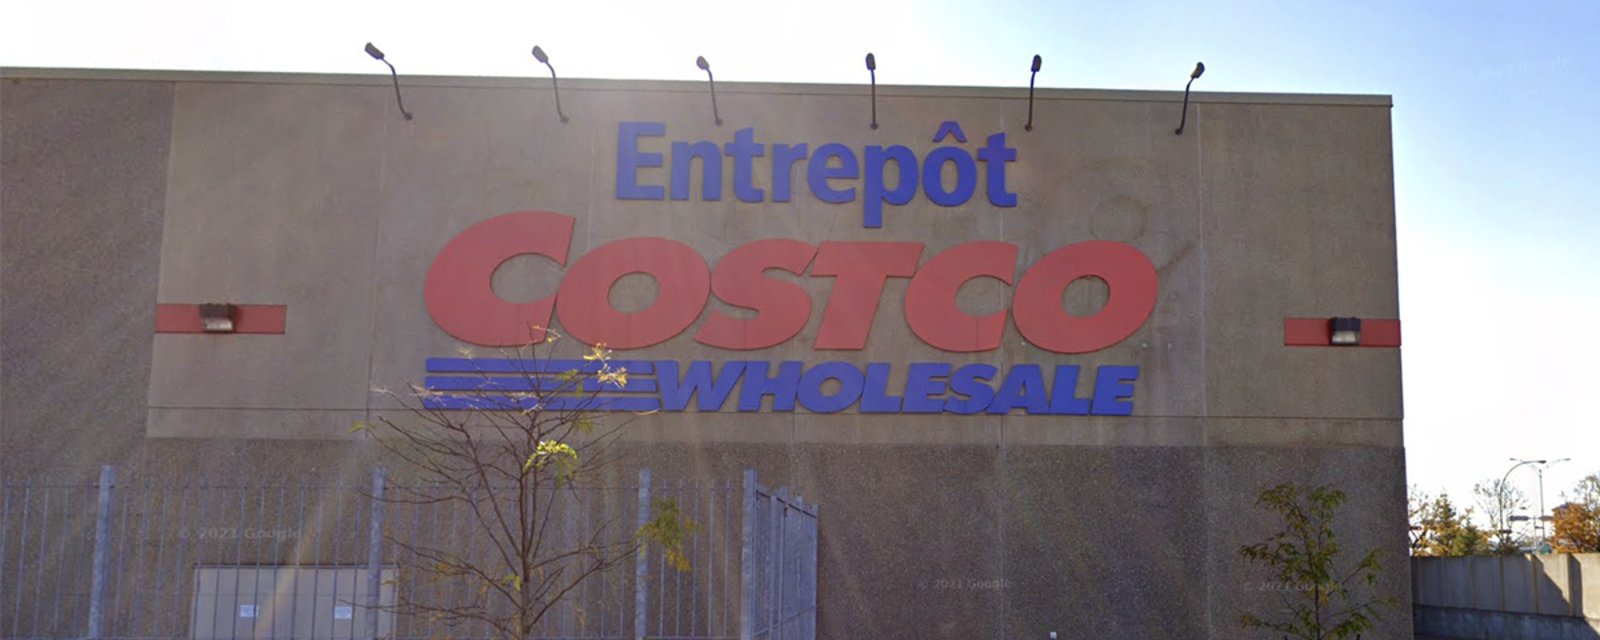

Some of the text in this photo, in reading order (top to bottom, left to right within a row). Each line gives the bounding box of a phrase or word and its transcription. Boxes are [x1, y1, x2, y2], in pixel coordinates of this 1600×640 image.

[615, 121, 1017, 227] Entrepôt
[424, 211, 1159, 354] COSTCO
[655, 360, 1139, 415] WHOLESALE
